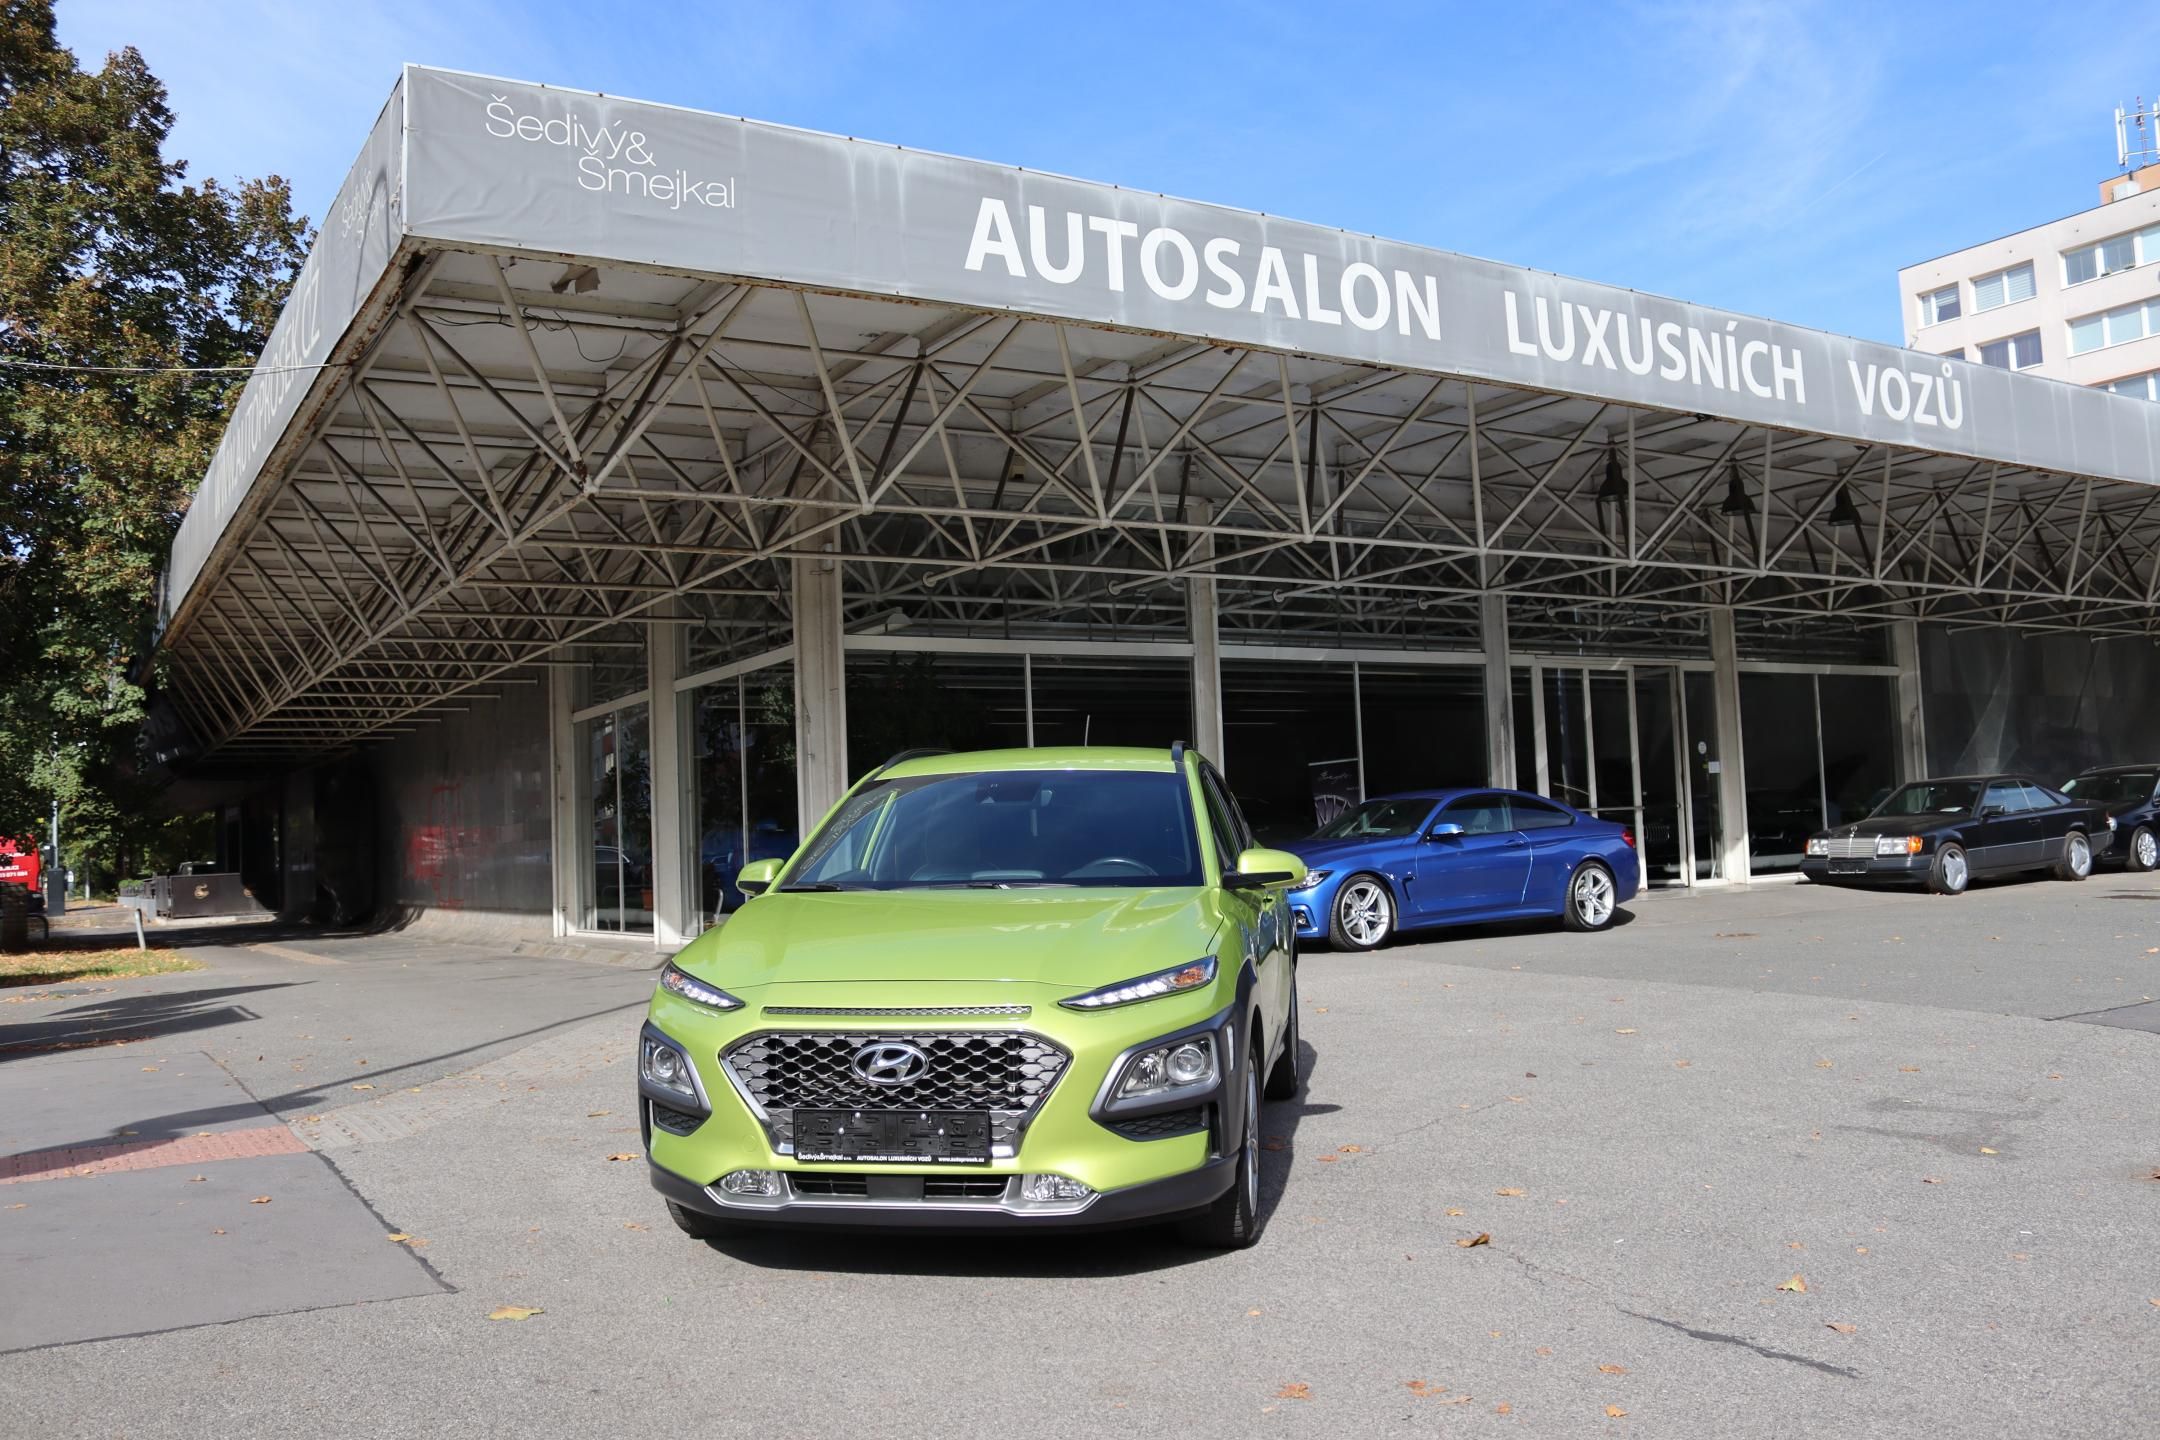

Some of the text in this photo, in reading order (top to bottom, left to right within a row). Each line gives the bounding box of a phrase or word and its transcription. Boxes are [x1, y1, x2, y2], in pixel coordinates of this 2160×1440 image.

[577, 146, 736, 210] Šmejkal
[964, 196, 1964, 430] AUTOSALON LUXUSNÍCH VOZŮ
